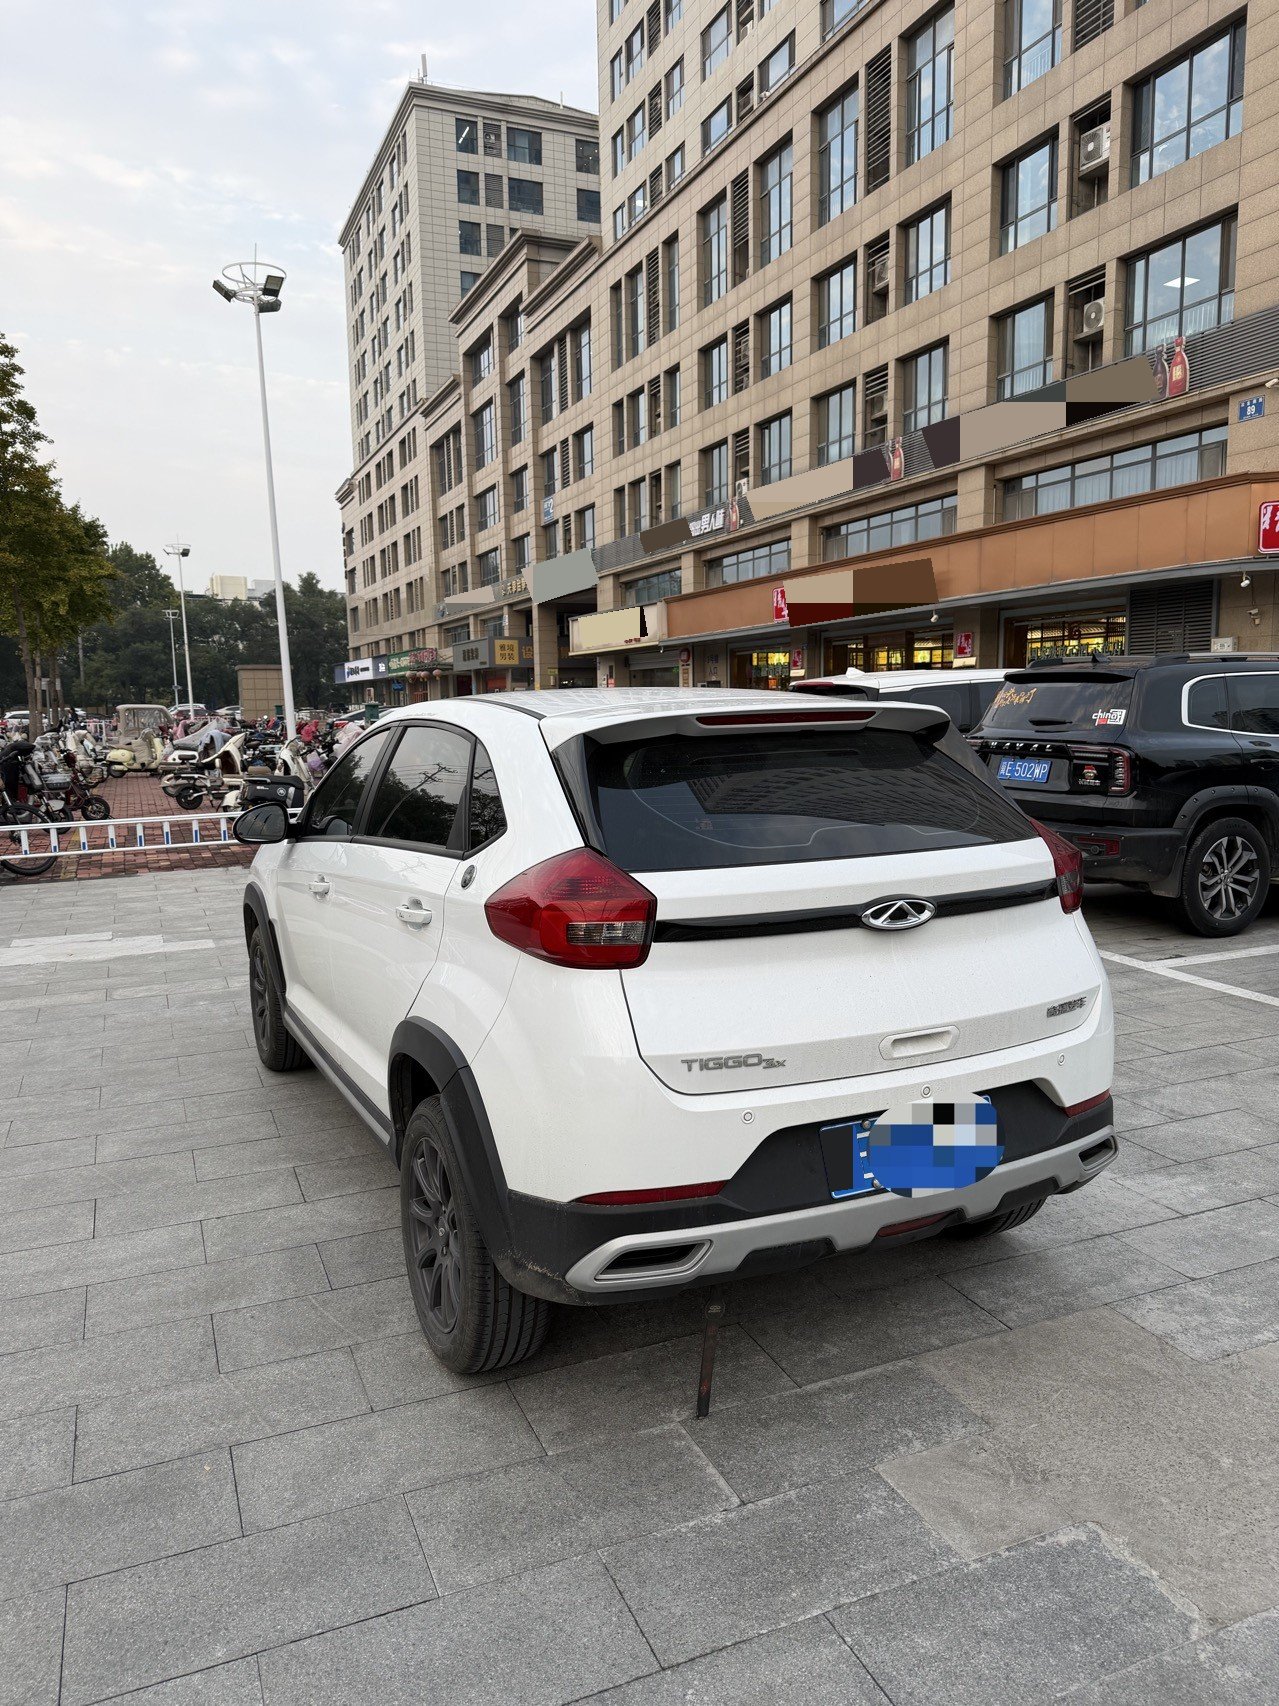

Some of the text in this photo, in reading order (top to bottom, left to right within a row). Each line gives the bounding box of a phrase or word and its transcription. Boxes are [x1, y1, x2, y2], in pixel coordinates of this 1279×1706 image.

[1246, 404, 1256, 415] 89
[990, 741, 1053, 752] HAVAL
[680, 1053, 762, 1072] TIGGO
